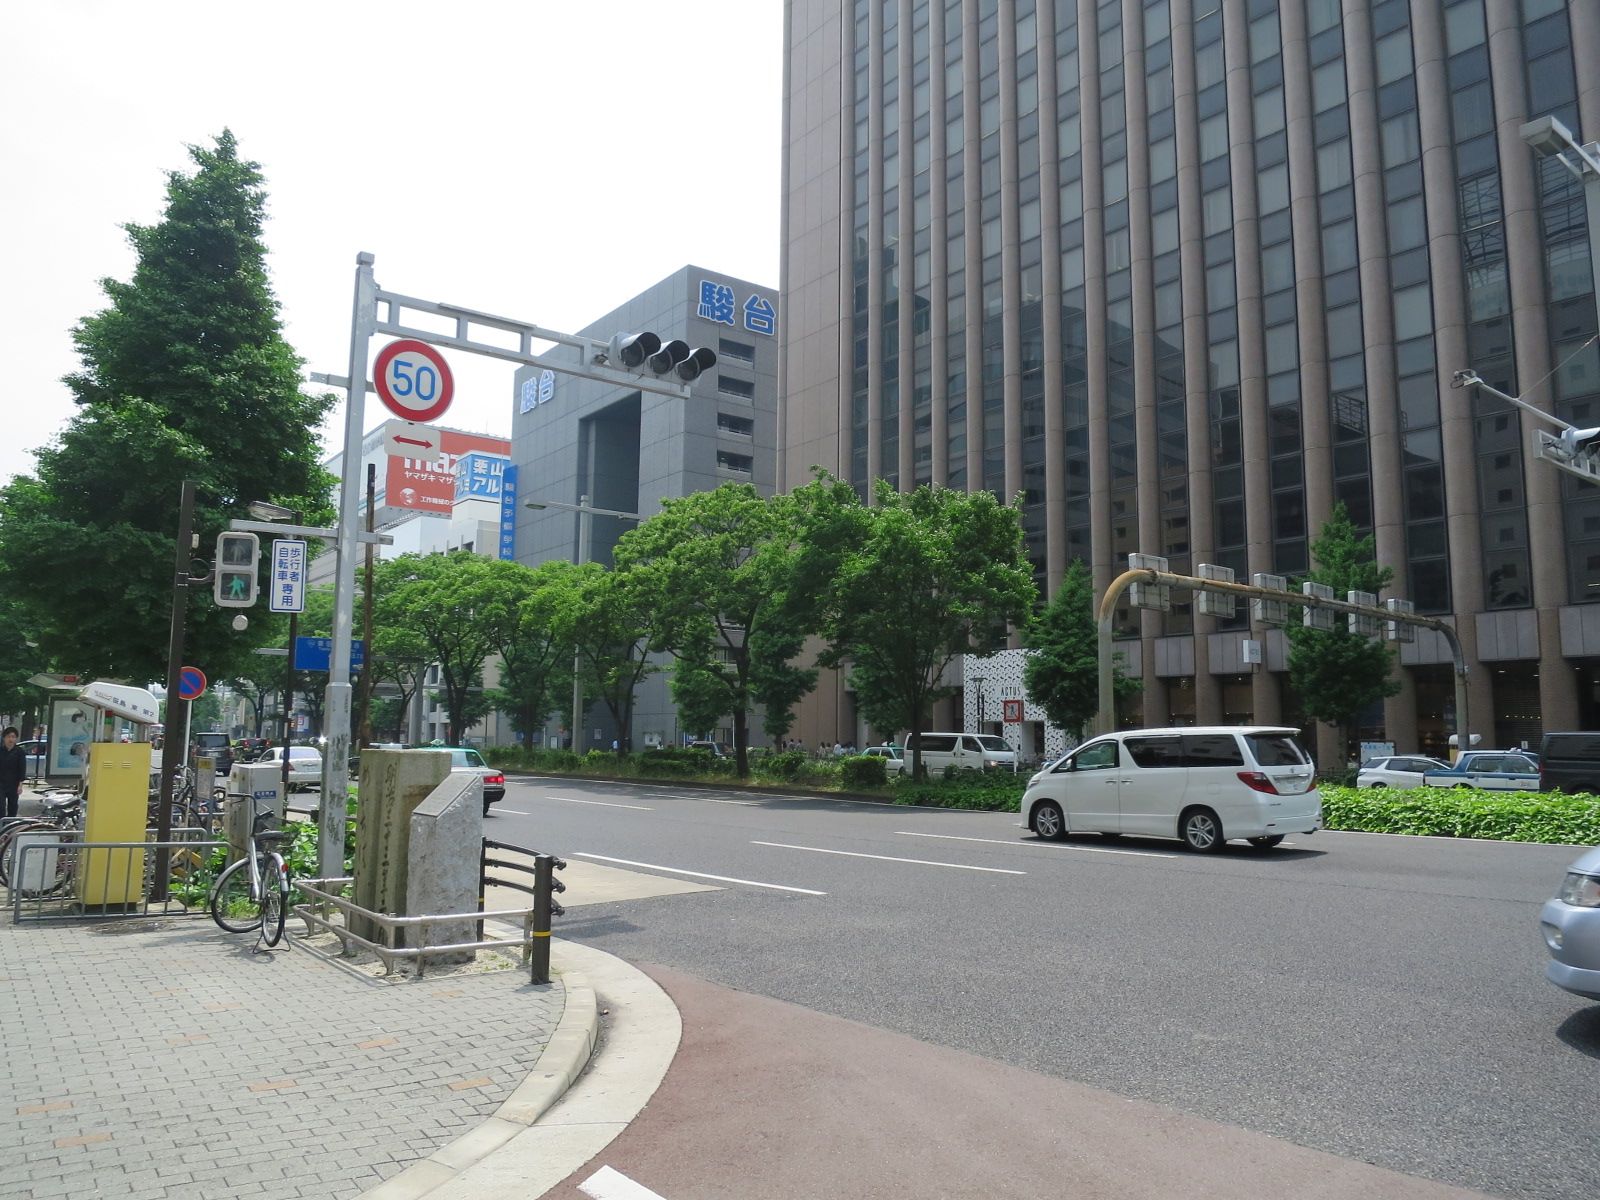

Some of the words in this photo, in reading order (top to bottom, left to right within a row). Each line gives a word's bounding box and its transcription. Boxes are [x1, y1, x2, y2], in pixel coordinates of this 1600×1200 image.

[697, 280, 776, 335] 駿台
[392, 359, 436, 401] 50
[520, 369, 555, 414] 駿台
[404, 470, 436, 482] ヤマザキ
[277, 547, 289, 581] 自転車
[289, 547, 301, 582] 歩行者
[281, 583, 293, 607] 専用
[1001, 686, 1021, 696] ACTUS
